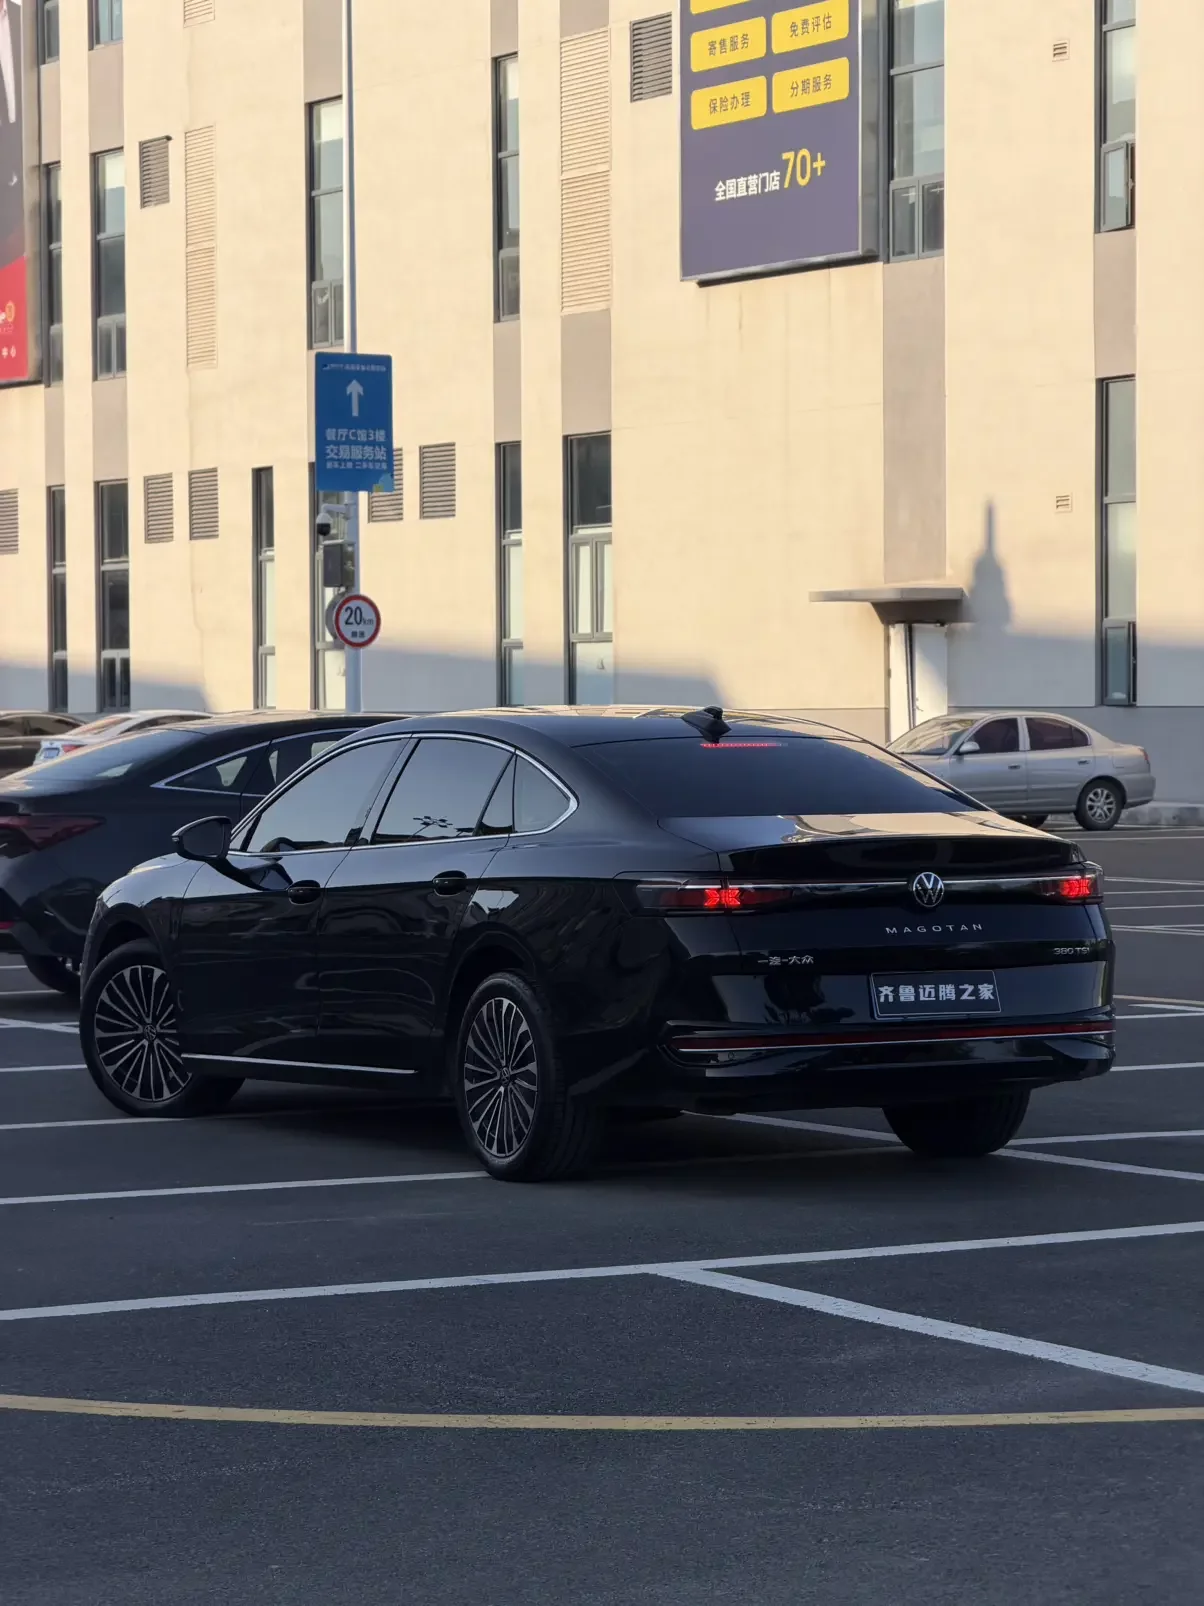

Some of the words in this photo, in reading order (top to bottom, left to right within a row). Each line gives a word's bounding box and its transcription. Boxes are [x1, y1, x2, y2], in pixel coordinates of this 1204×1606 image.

[789, 13, 832, 38] 免费评估
[708, 33, 750, 57] 寄售服务
[790, 73, 833, 98] 分期服务
[708, 91, 751, 115] 保险办理
[325, 445, 387, 461] 交易服务站
[885, 923, 983, 934] MAGOTAN
[878, 983, 995, 1003] 齐鲁迈腾之家
